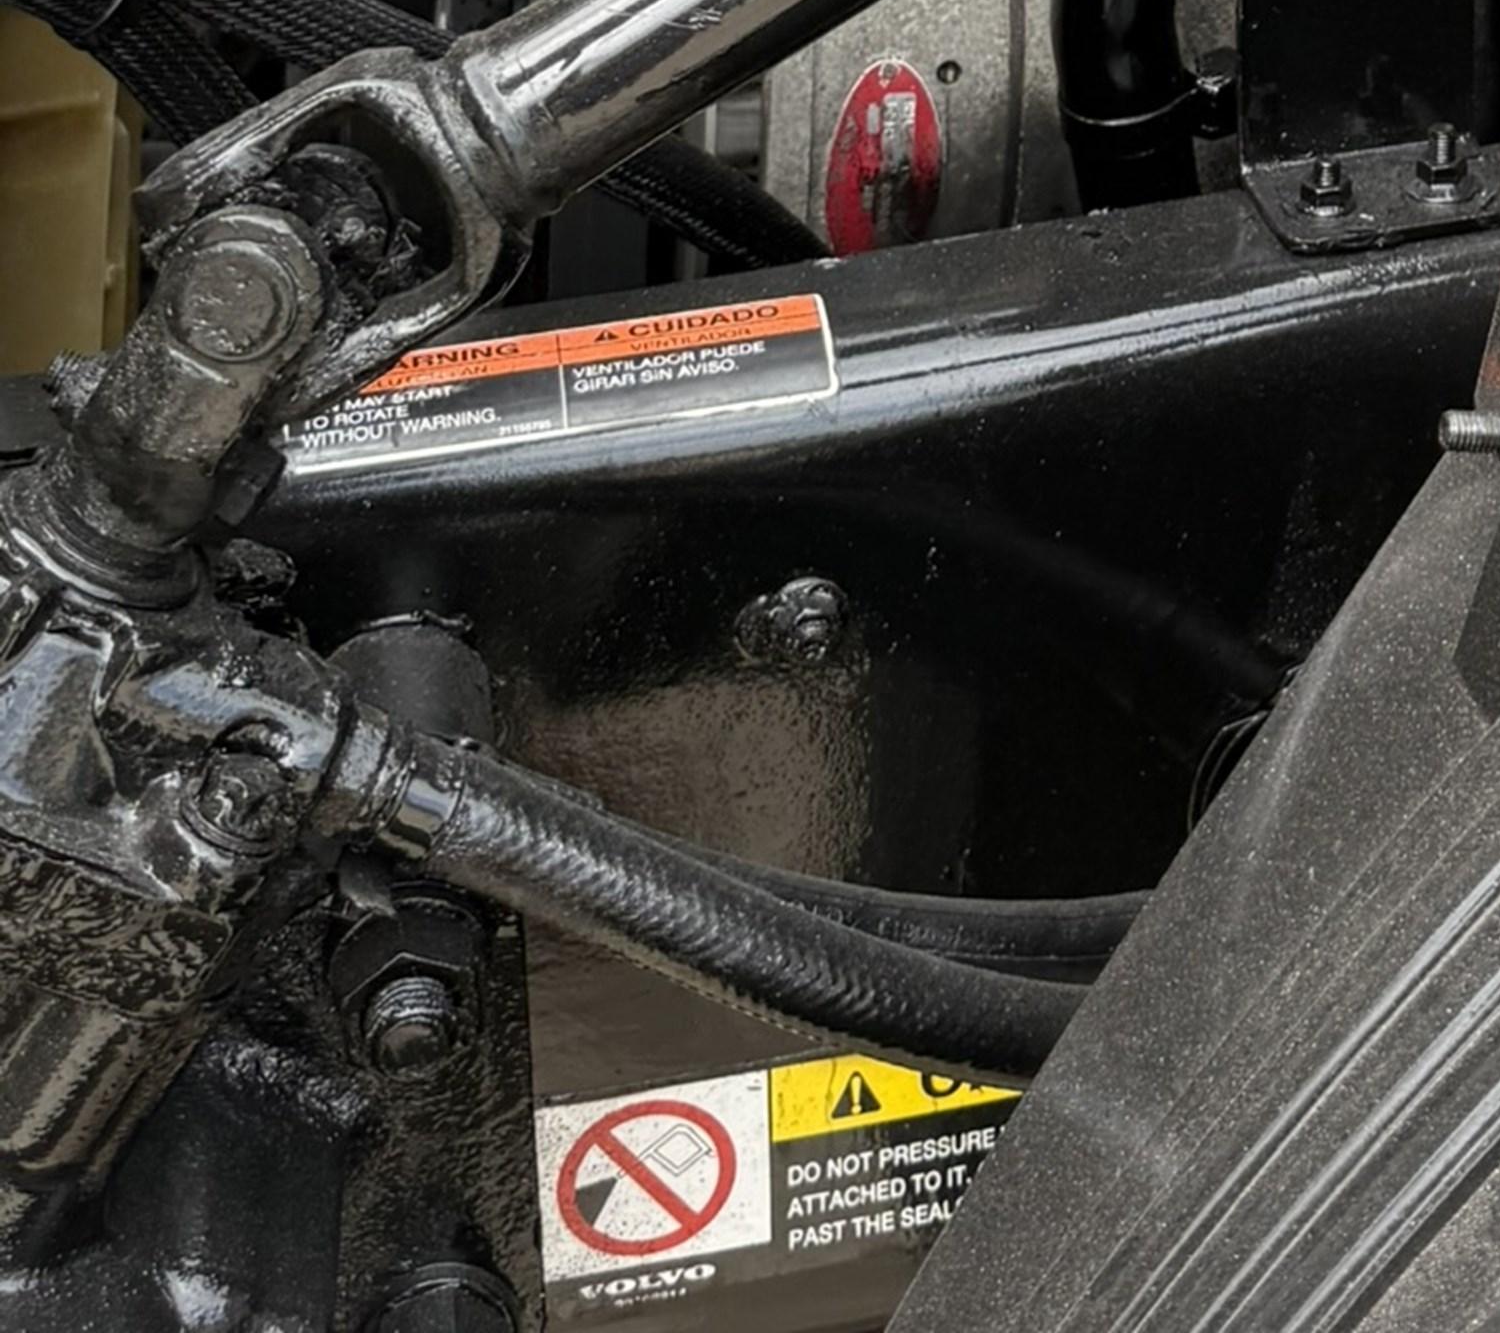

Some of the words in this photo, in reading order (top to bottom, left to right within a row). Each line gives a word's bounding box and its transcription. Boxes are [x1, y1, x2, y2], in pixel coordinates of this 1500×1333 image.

[628, 305, 779, 337] CUIDADO
[397, 341, 520, 371] ARNING
[630, 327, 752, 352] VENTILADOR
[572, 348, 696, 379] VENTILADOR
[699, 340, 767, 361] PUEDE
[573, 372, 636, 394] GIRAR
[640, 367, 674, 384] SIN
[677, 358, 740, 380] AVISO.
[334, 404, 410, 425] ROTATE
[344, 394, 390, 412] MAY
[391, 385, 454, 406] START
[300, 420, 397, 449] WITHOUT
[401, 407, 502, 434] WARNING.
[786, 1160, 822, 1188] DO
[826, 1151, 874, 1180] NOT
[878, 1126, 997, 1170] PRESSURE
[786, 1178, 907, 1220] ATTACHED
[910, 1169, 942, 1195] TO
[946, 1164, 973, 1188] IT.
[787, 1219, 847, 1252] PAST
[851, 1210, 896, 1239] THE
[899, 1195, 964, 1229] SEAL
[578, 1263, 717, 1300] VOLVO
